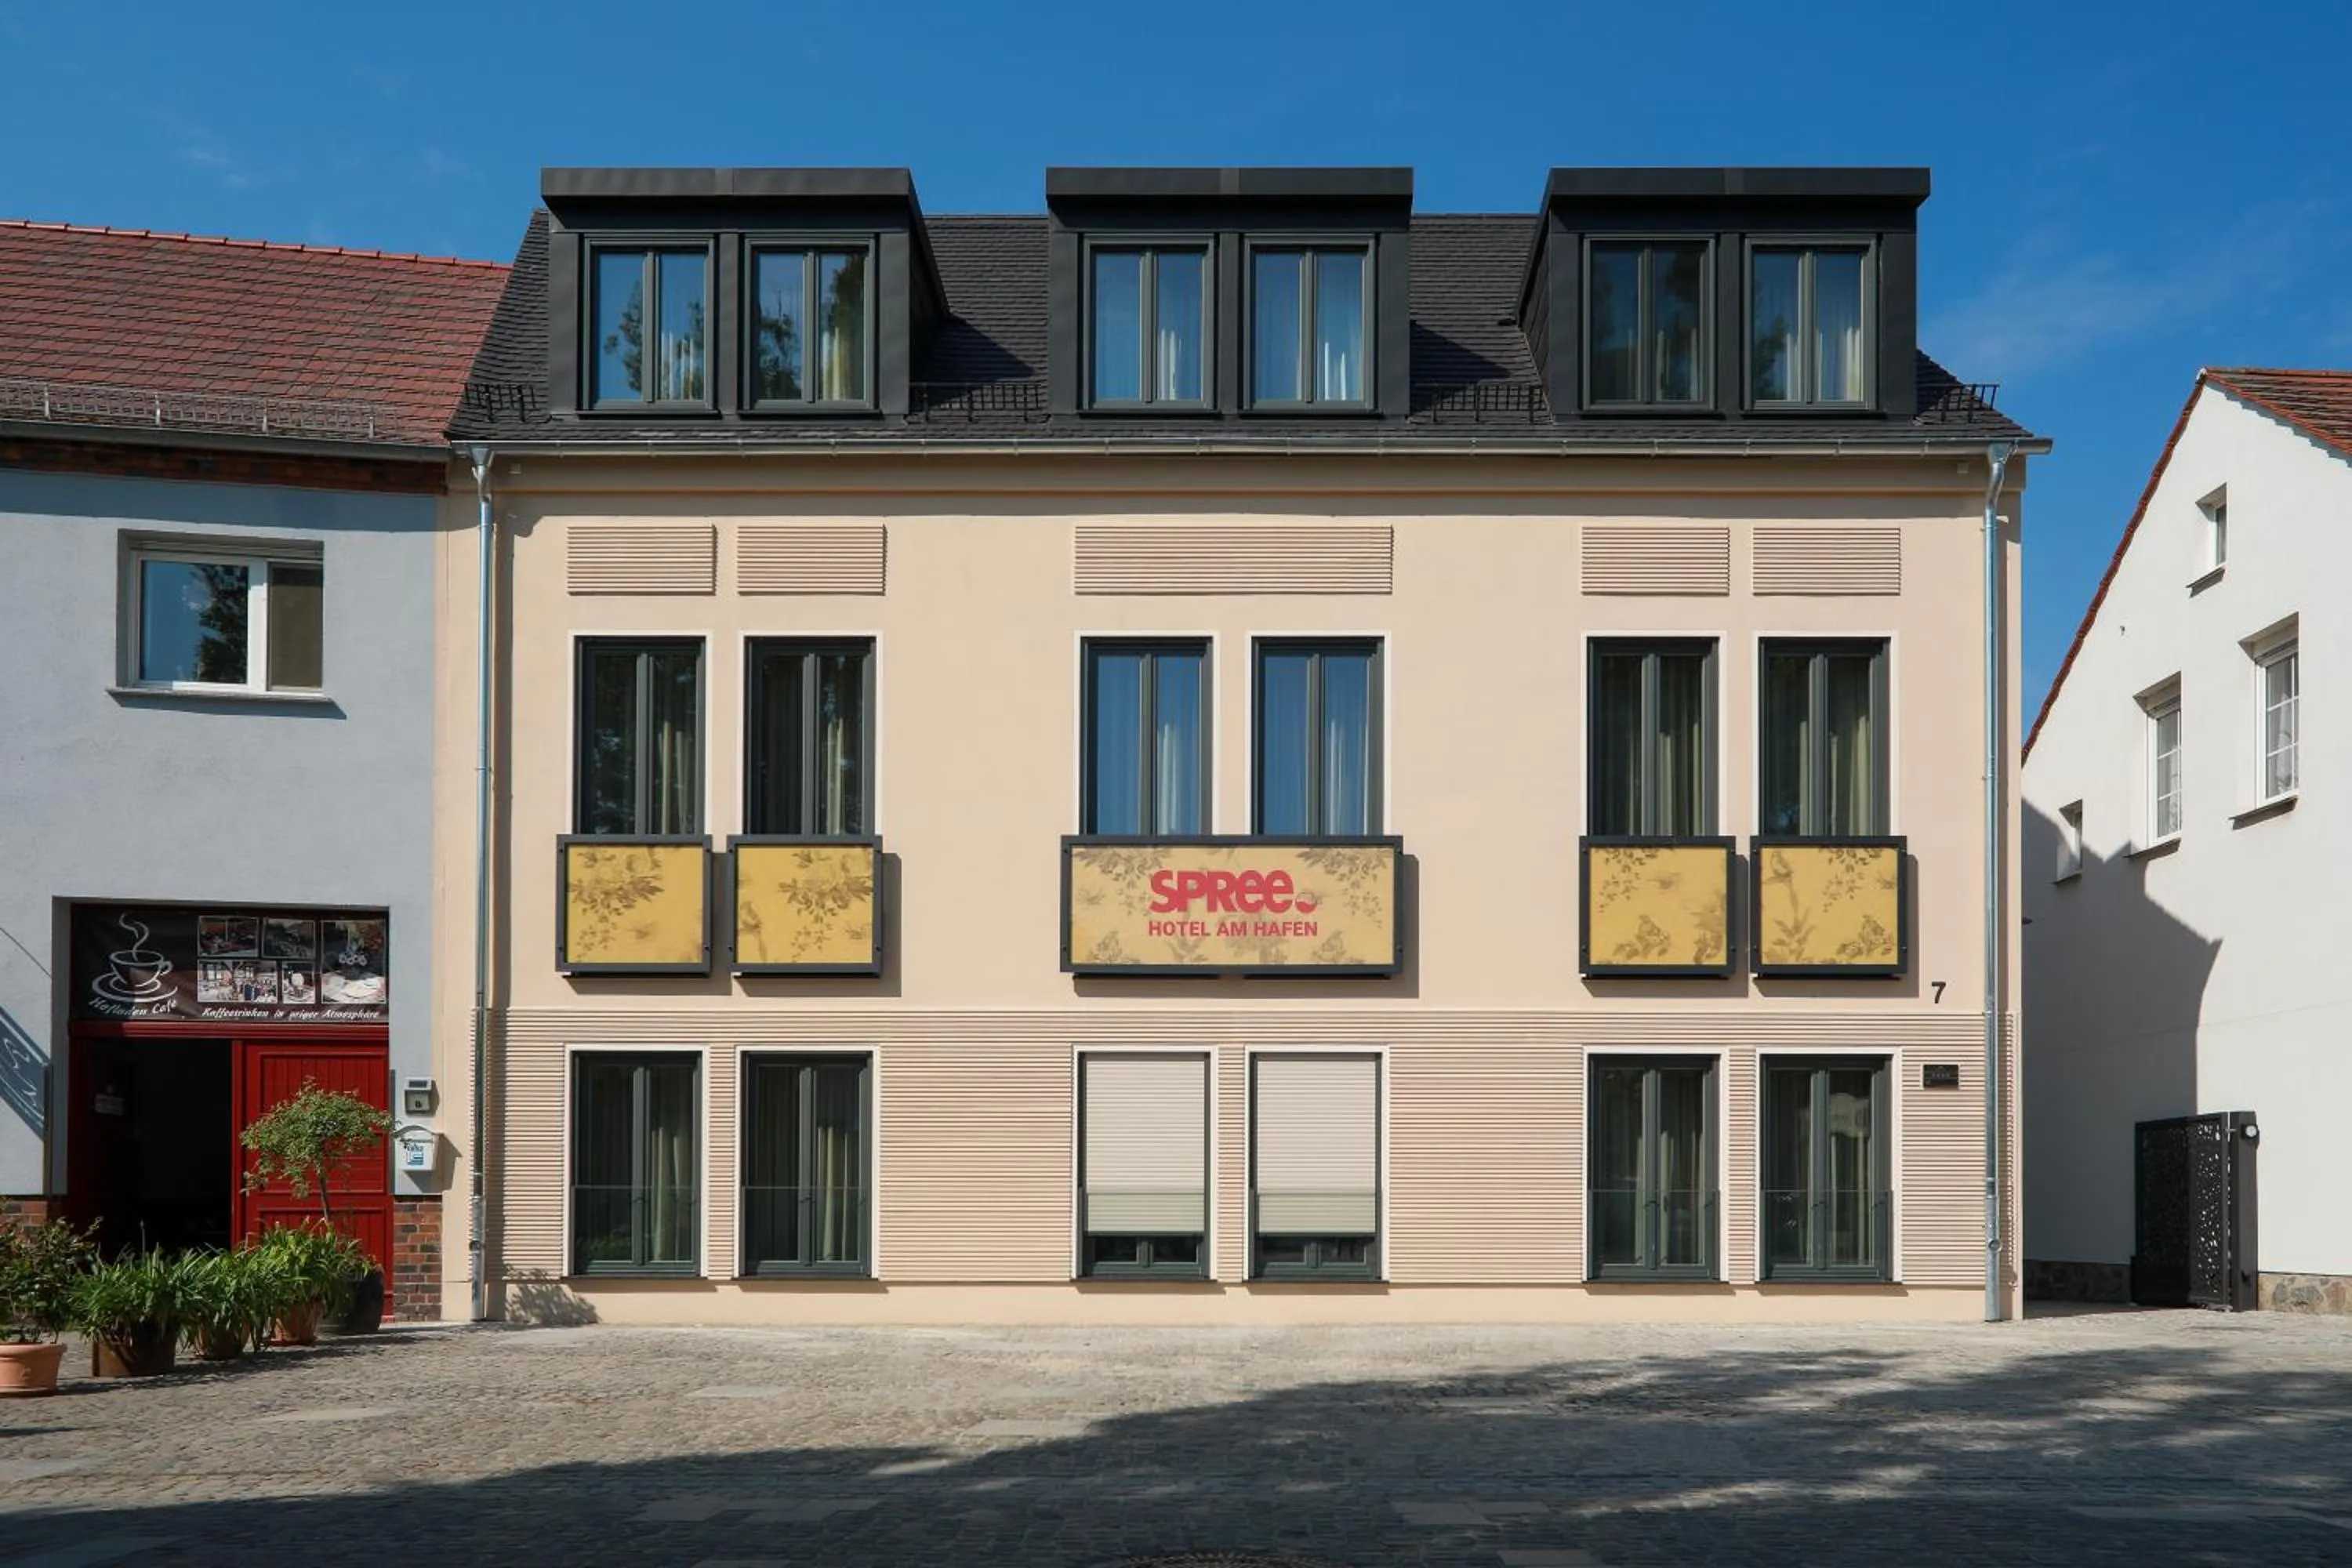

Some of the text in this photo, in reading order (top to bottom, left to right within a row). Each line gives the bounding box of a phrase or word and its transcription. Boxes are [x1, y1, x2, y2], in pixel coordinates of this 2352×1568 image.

[1149, 920, 1318, 937] HOTEL AM HAFEN
[1931, 981, 1947, 1004] 7
